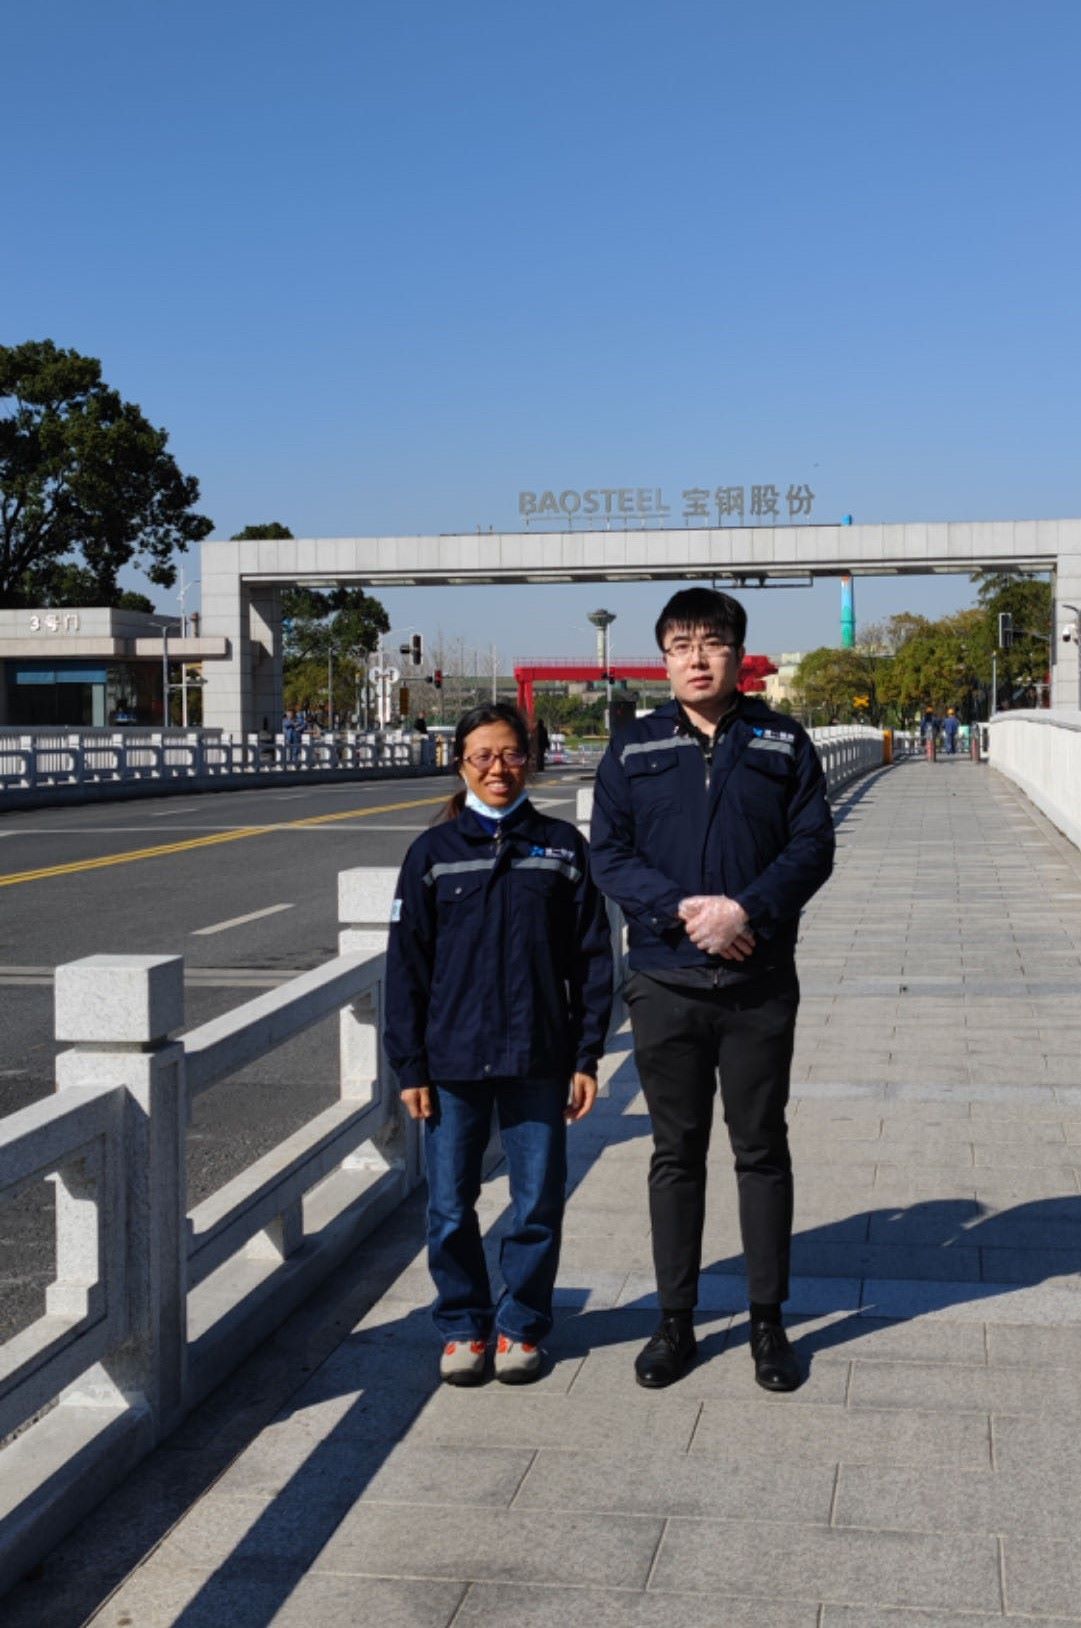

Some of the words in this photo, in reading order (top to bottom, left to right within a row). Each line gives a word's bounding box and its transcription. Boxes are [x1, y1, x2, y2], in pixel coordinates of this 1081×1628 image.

[518, 488, 670, 514] BAOSTEEL
[682, 484, 815, 517] 宝钢股份
